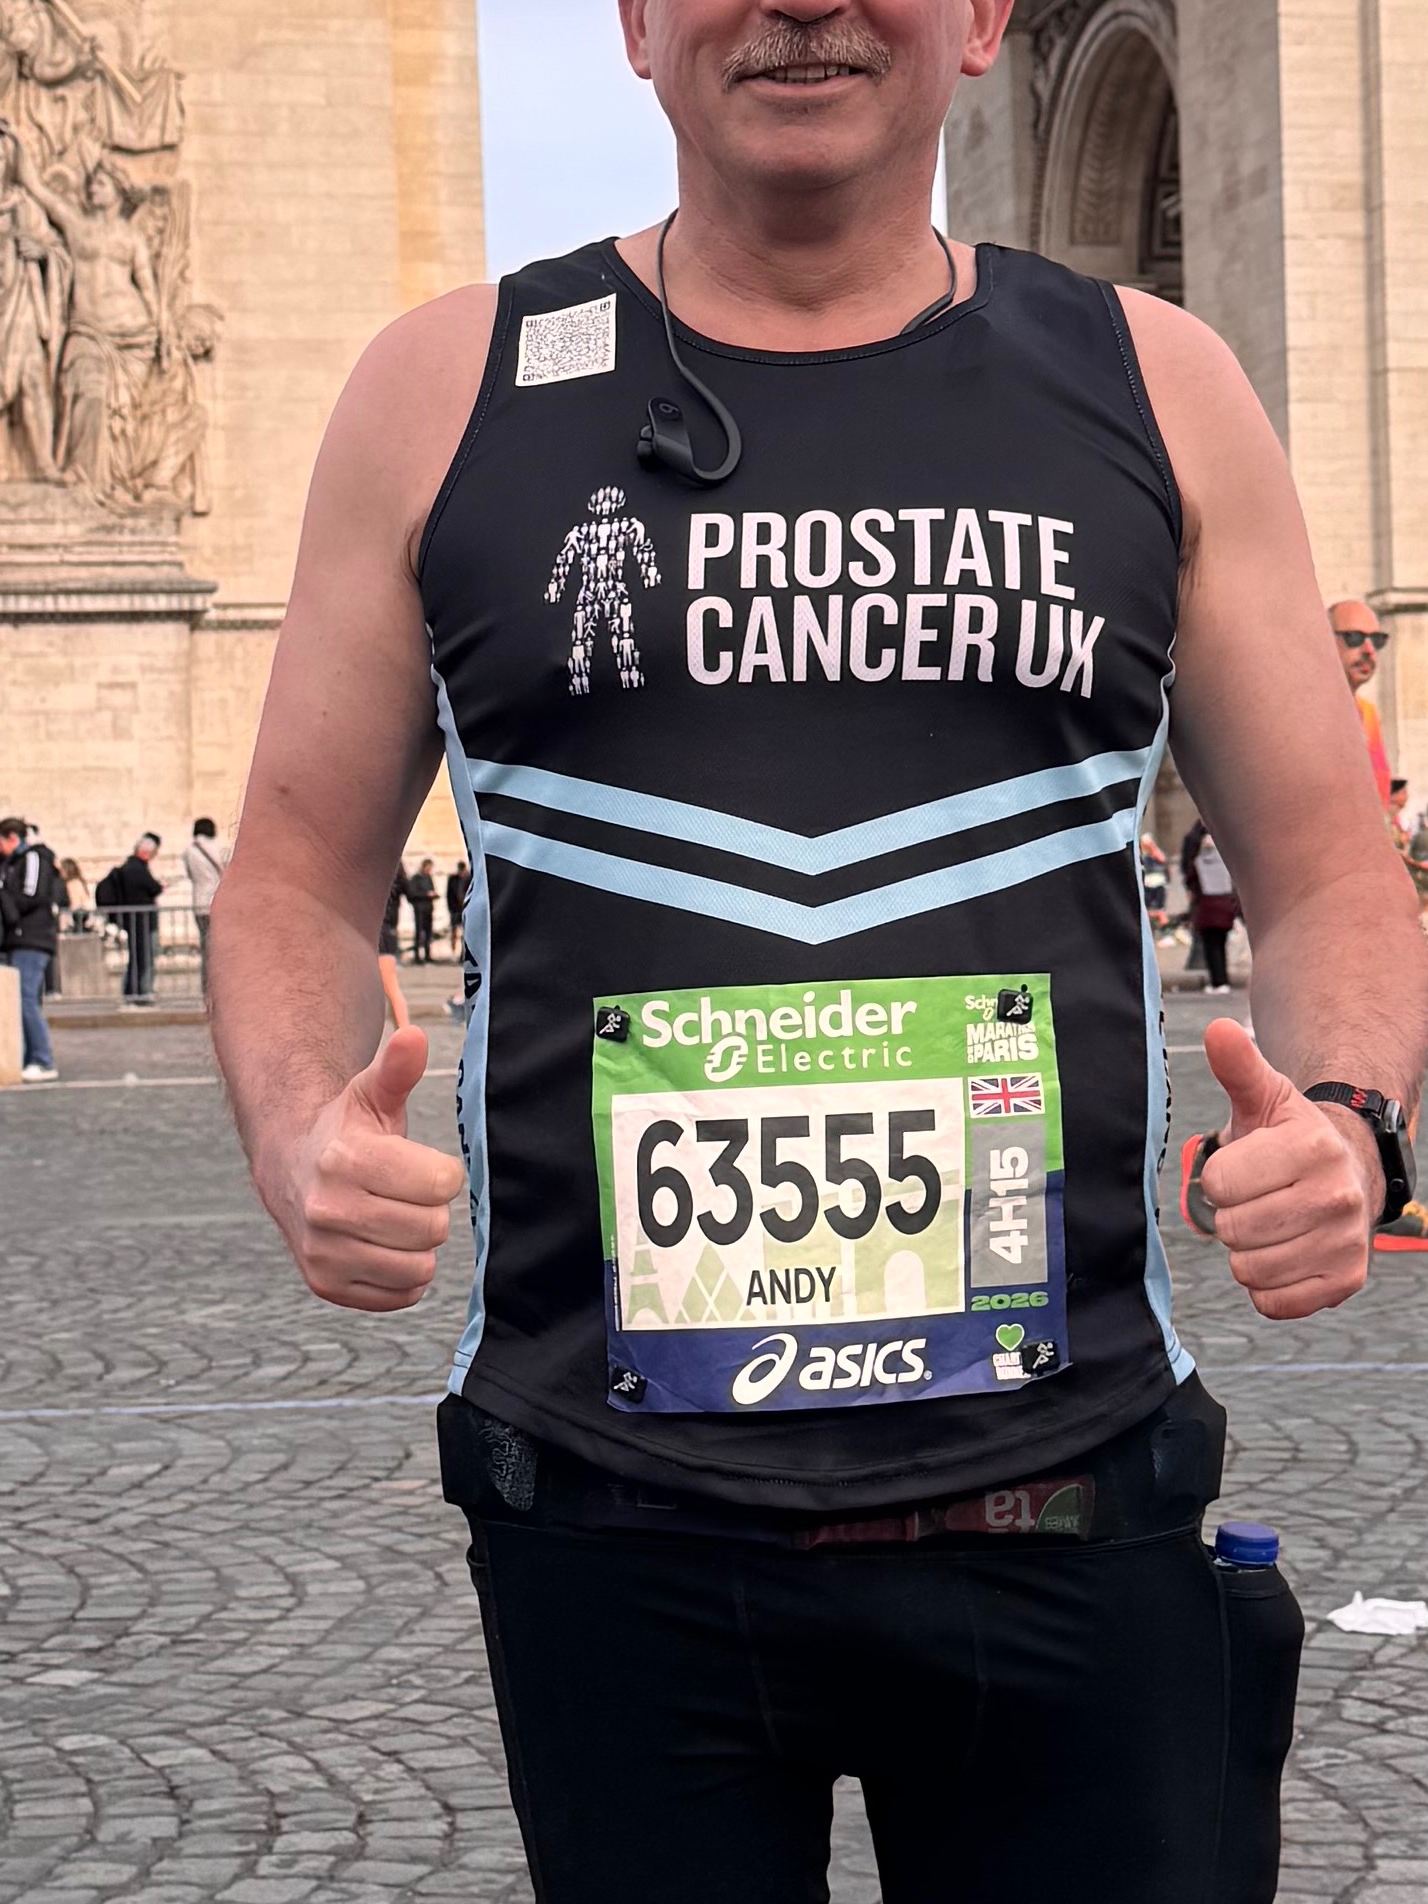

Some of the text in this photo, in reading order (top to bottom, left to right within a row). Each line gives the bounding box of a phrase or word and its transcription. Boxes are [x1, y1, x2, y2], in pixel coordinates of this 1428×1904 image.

[687, 507, 1076, 601] PROSTATE
[686, 593, 1106, 699] CANCER UK
[640, 989, 918, 1048] Schneider
[974, 1033, 1039, 1063] PARIS
[756, 1041, 913, 1074] Electric
[636, 1109, 942, 1249] 63555
[989, 1146, 1030, 1264] 4H15
[745, 1266, 837, 1306] ANDY
[970, 1290, 1049, 1311] 2026
